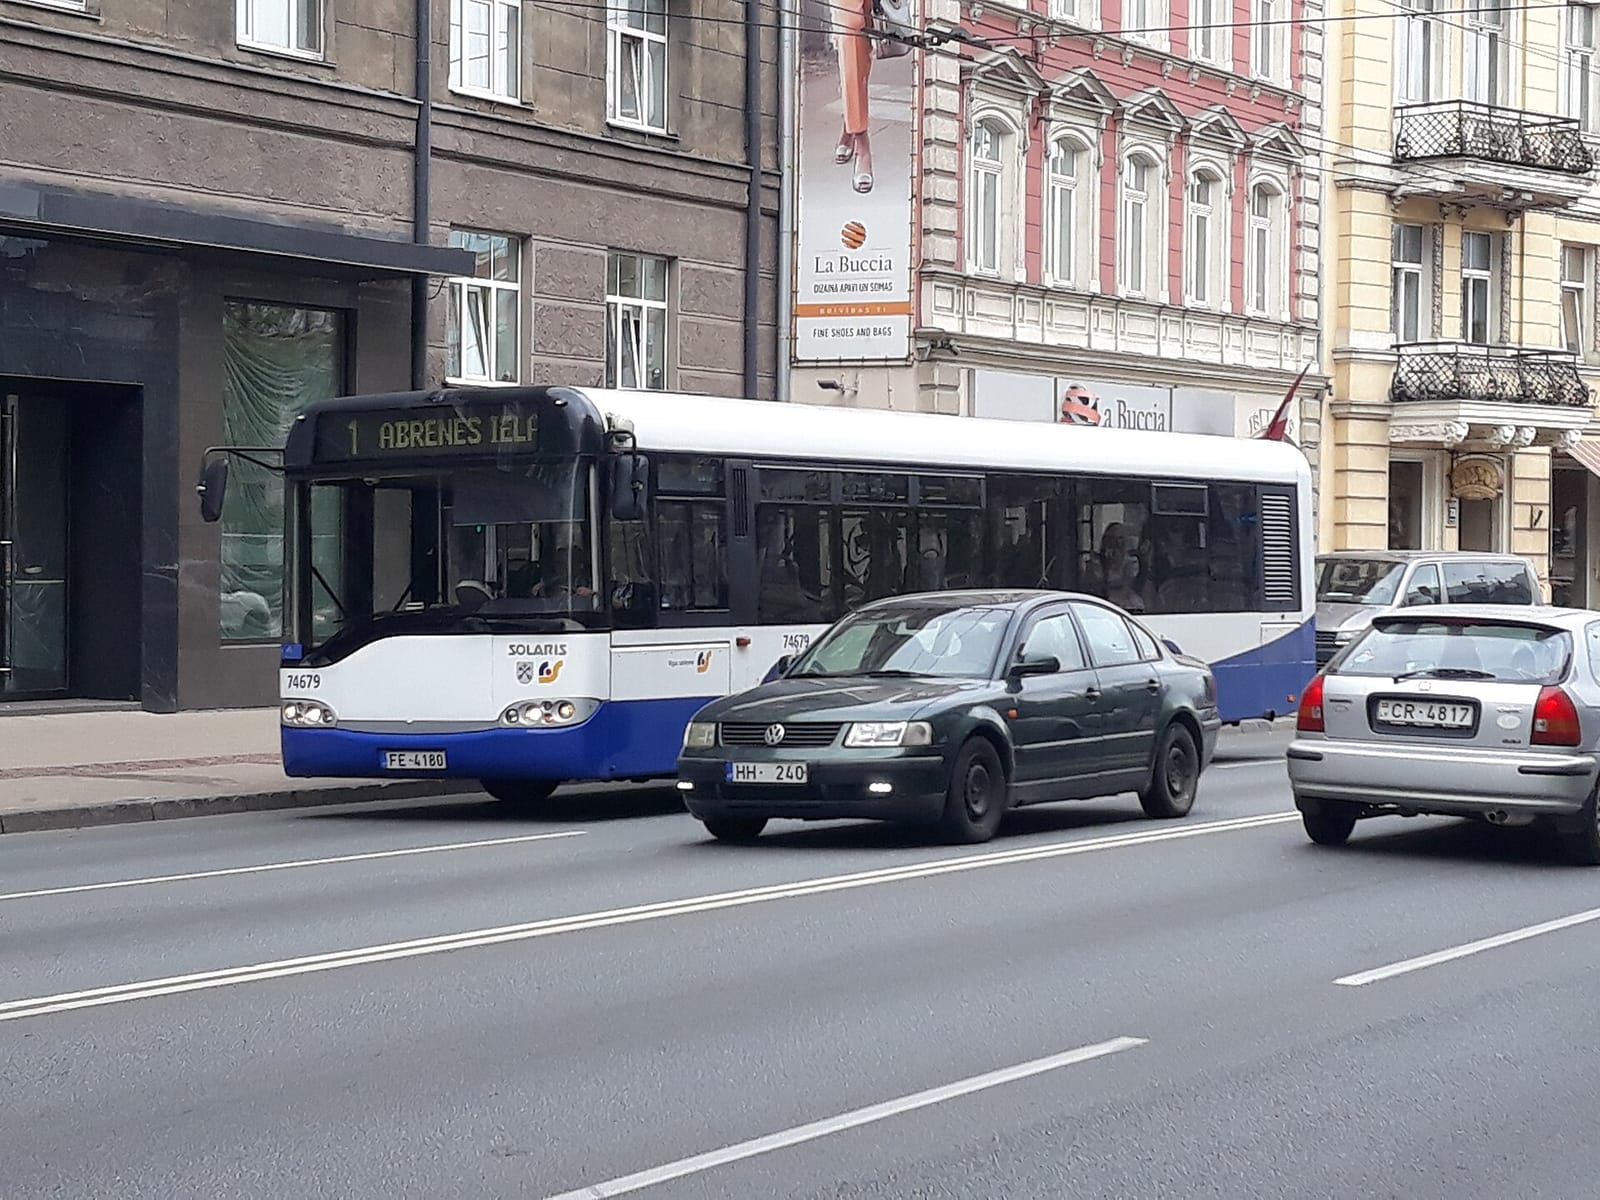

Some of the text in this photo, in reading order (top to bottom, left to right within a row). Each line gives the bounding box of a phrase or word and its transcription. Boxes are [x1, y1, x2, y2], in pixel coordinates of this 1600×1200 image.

[815, 254, 893, 274] La Buccia
[813, 326, 892, 338] FINE SHOES AND BAGS
[1117, 399, 1165, 432] Buccia
[348, 419, 357, 455] 1
[379, 415, 482, 449] ABRENES
[783, 634, 810, 649] 74679
[508, 644, 567, 656] SOLARIS
[287, 674, 321, 689] 74679
[1391, 703, 1470, 723] CR-4817
[389, 753, 444, 767] FE-4180
